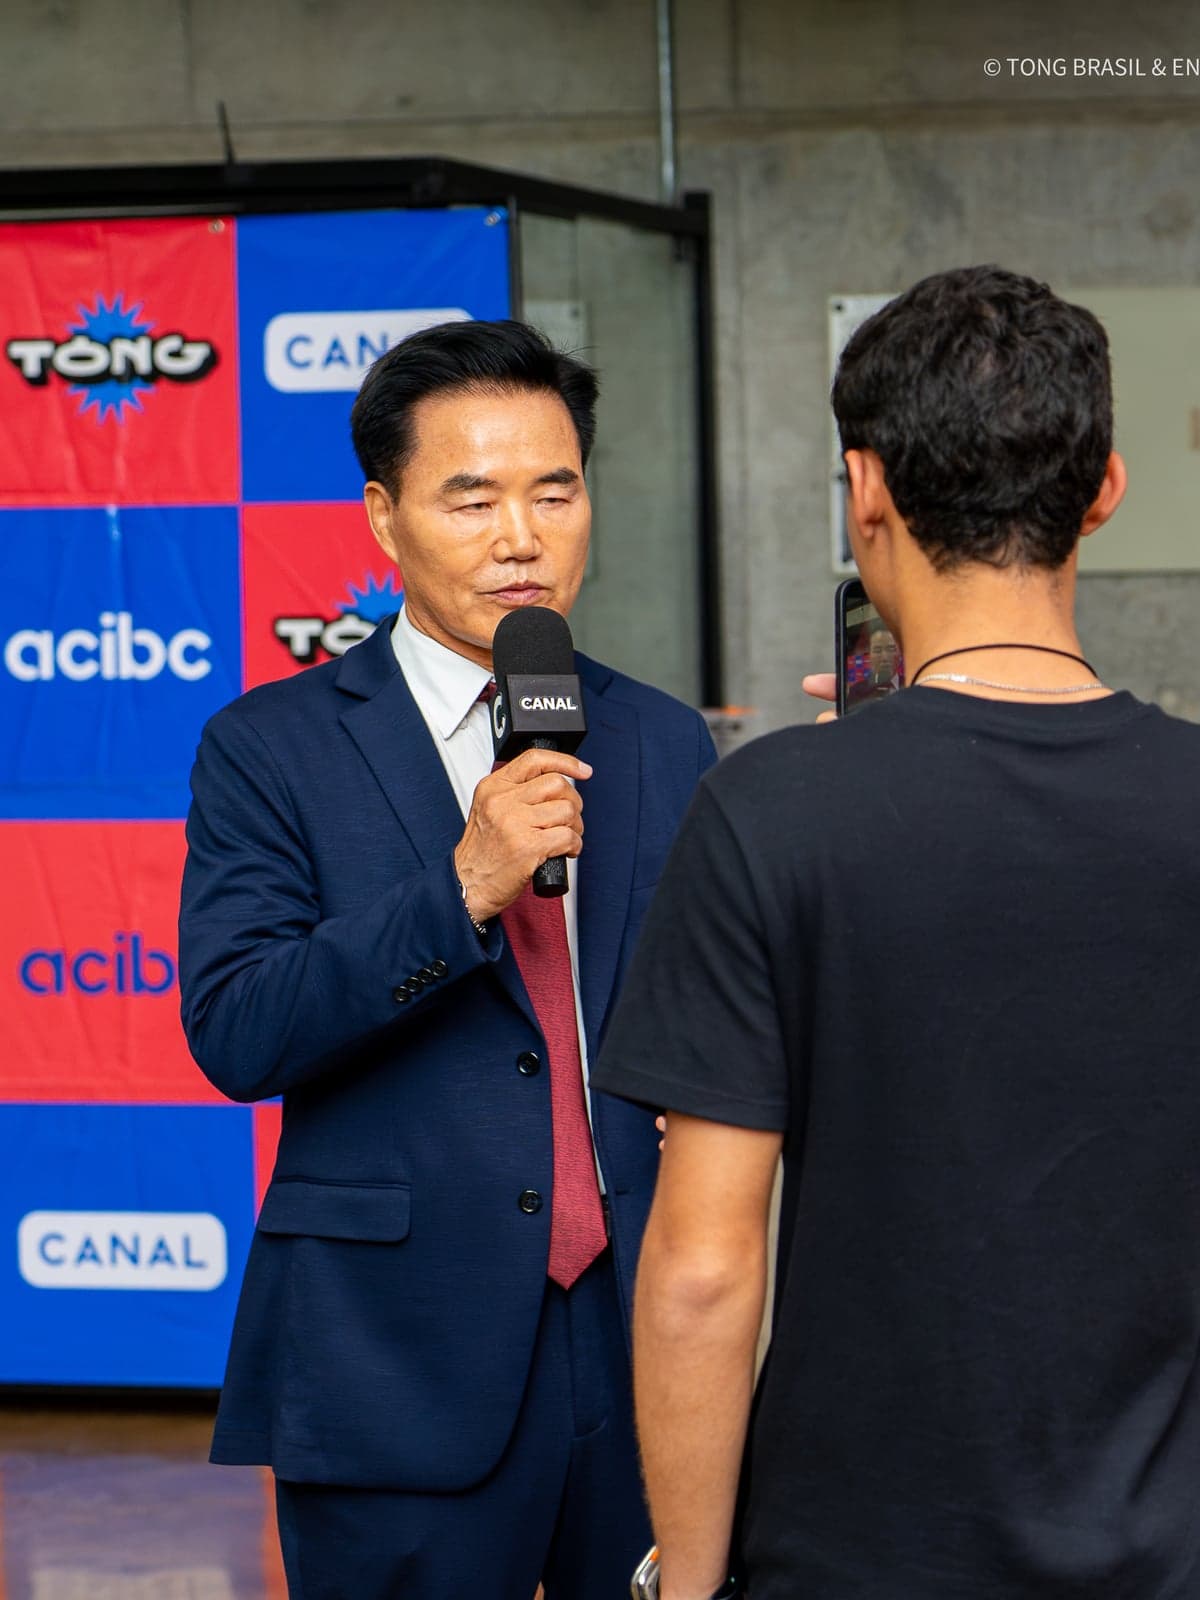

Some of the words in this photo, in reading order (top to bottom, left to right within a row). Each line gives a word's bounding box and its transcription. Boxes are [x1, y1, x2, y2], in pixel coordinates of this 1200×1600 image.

[6, 331, 215, 385] TONG
[284, 331, 389, 370] CAN
[4, 612, 211, 681] acibc
[274, 612, 379, 663] TO
[519, 696, 579, 711] CANAL
[19, 931, 177, 995] acib
[38, 1231, 208, 1270] CANAL
